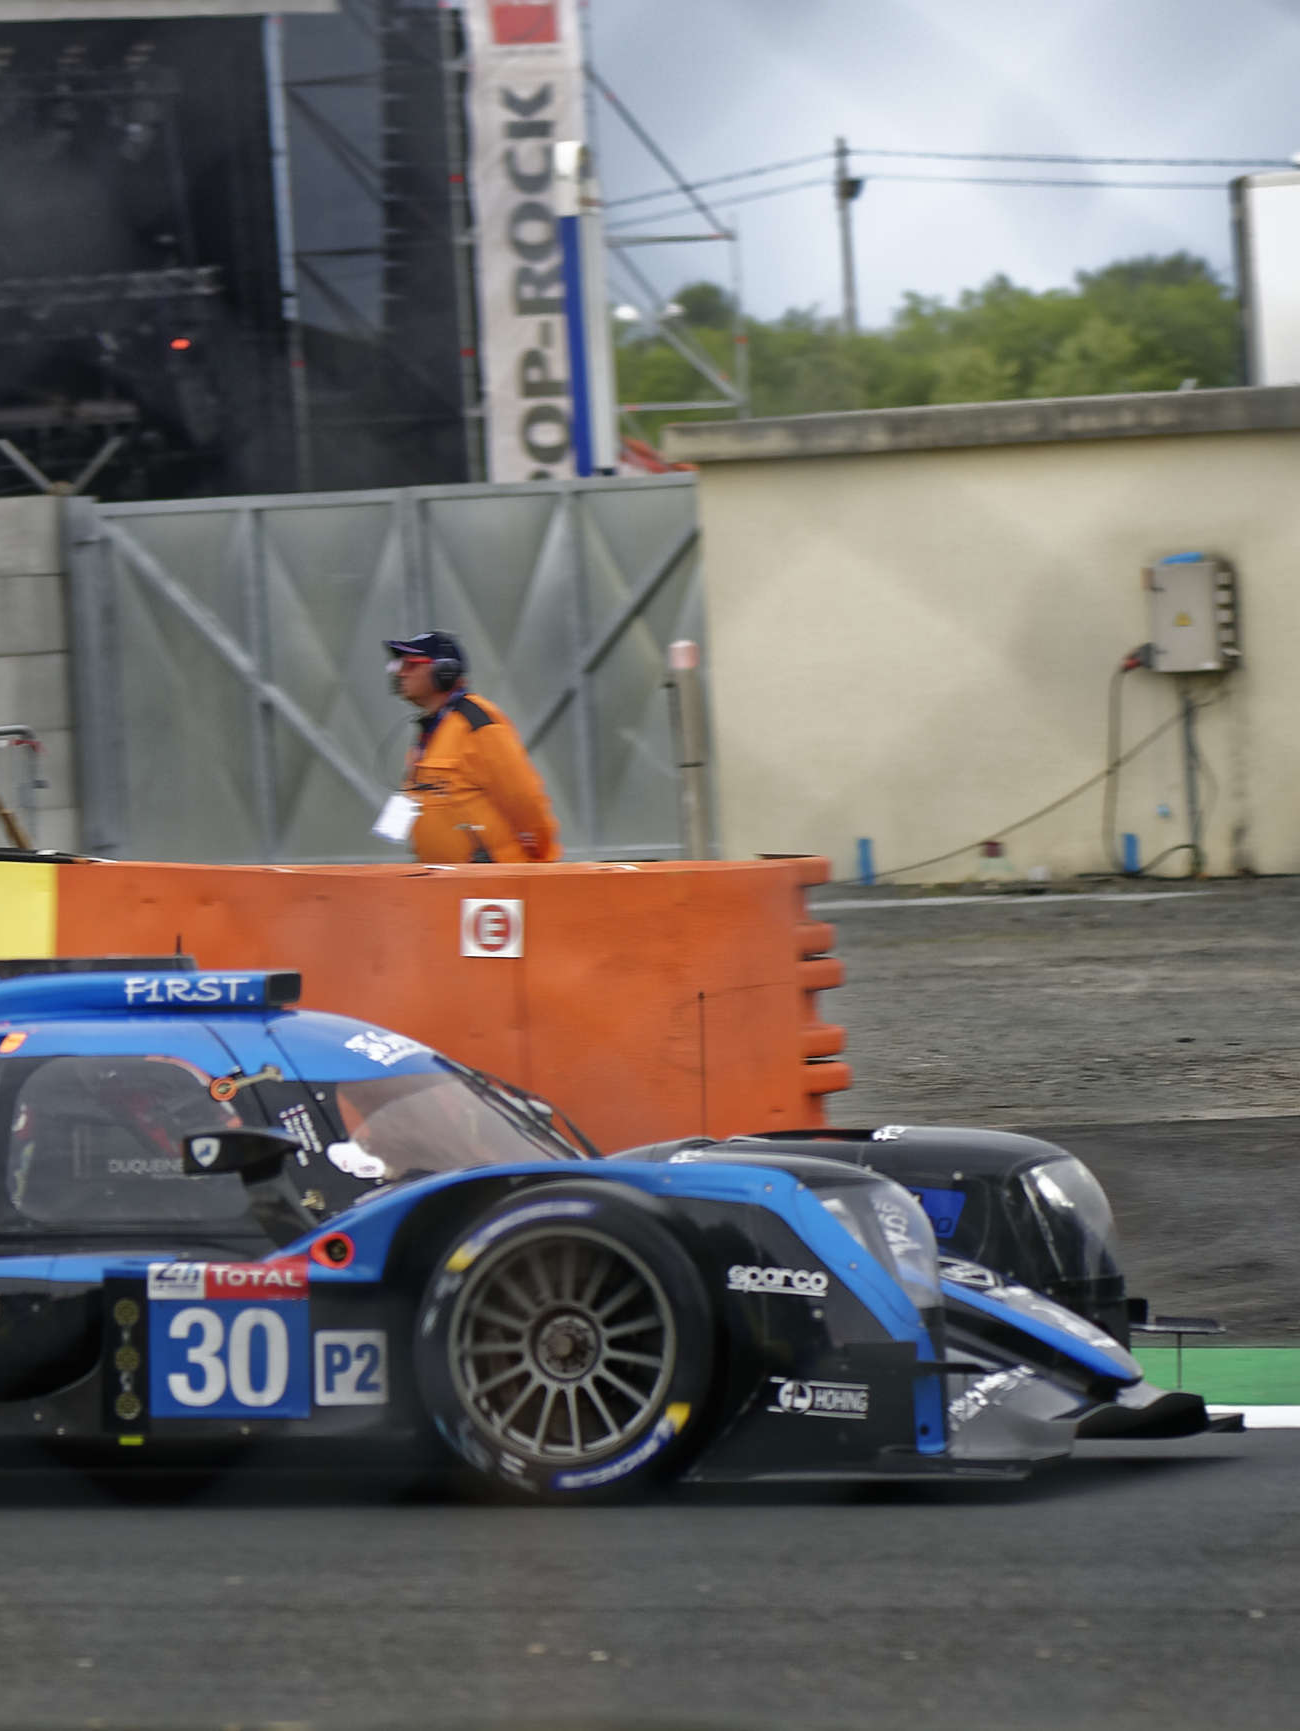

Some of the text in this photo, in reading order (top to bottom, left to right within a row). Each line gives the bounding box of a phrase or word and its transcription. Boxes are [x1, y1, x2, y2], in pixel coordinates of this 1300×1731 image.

[501, 81, 573, 481] OP-ROCK
[480, 911, 508, 944] E
[210, 1263, 304, 1288] TOTAL
[727, 1264, 829, 1297] sparco
[167, 1306, 290, 1407] 30
[323, 1342, 381, 1395] P2
